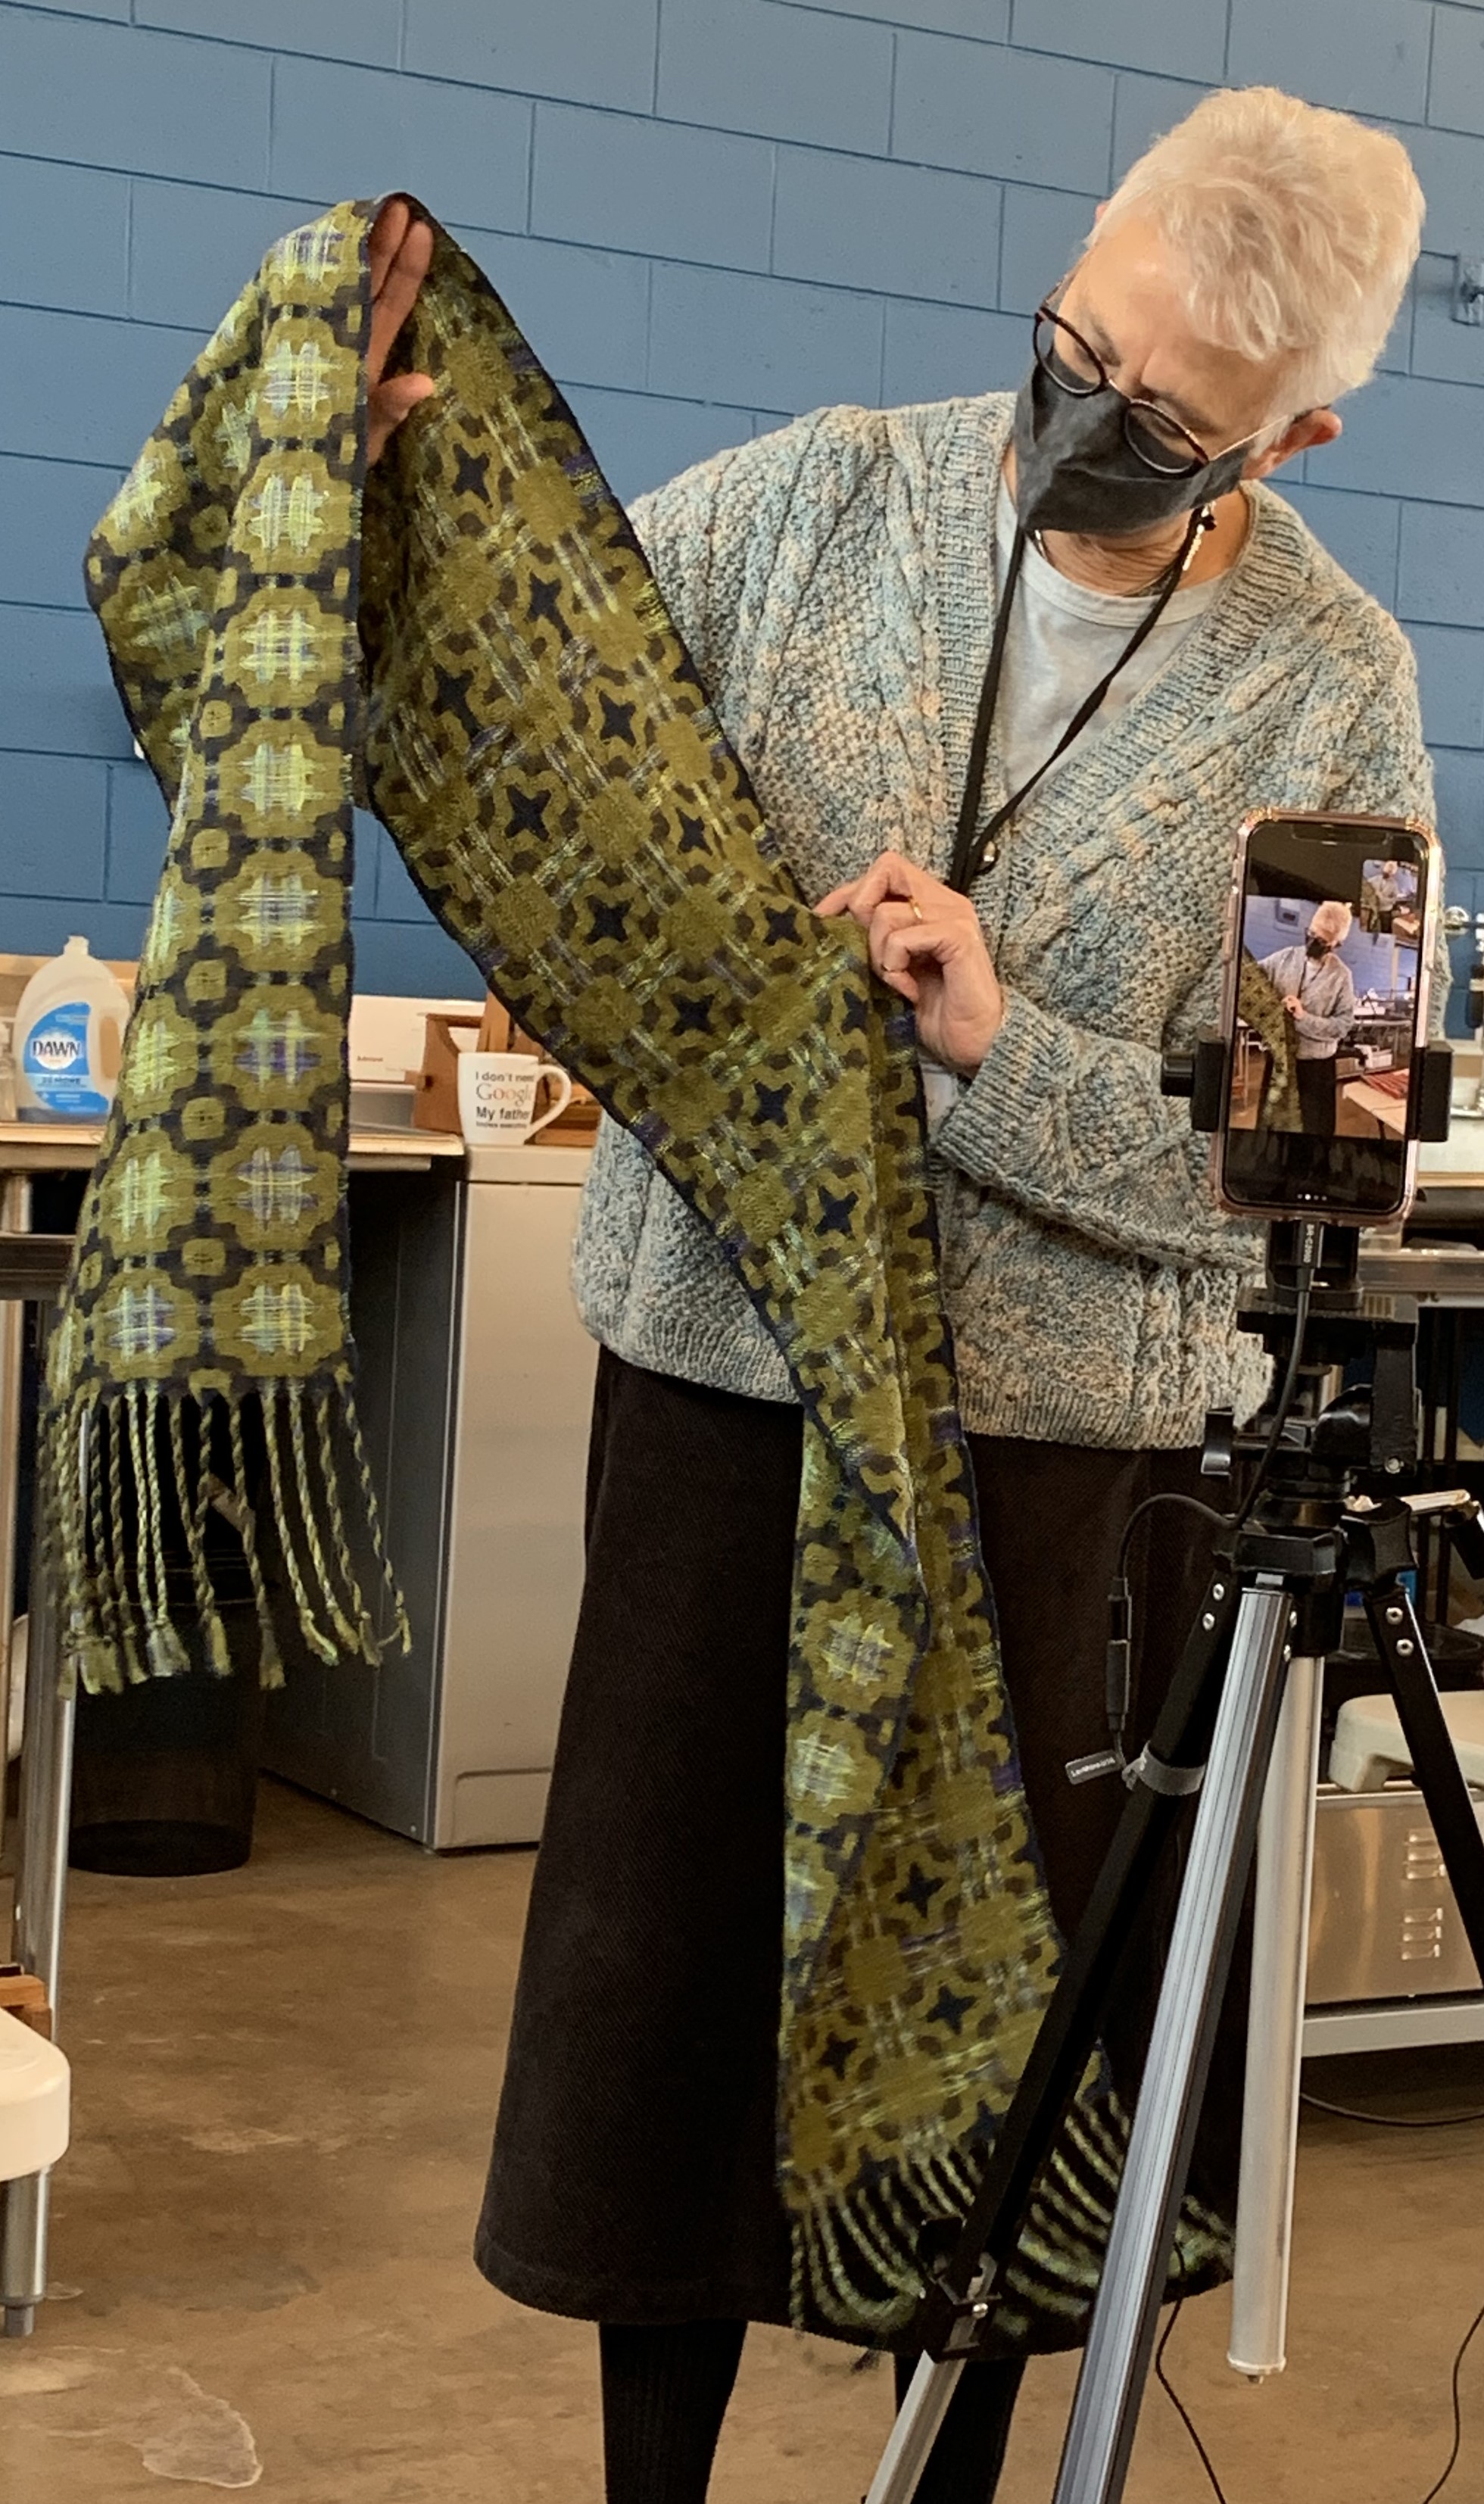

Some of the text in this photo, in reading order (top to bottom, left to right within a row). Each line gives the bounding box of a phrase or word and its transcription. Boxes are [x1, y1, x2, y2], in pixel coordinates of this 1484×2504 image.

[33, 1040, 81, 1057] DAWN
[475, 1071, 479, 1080] I
[482, 1071, 513, 1082] don't
[475, 1106, 495, 1121] My
